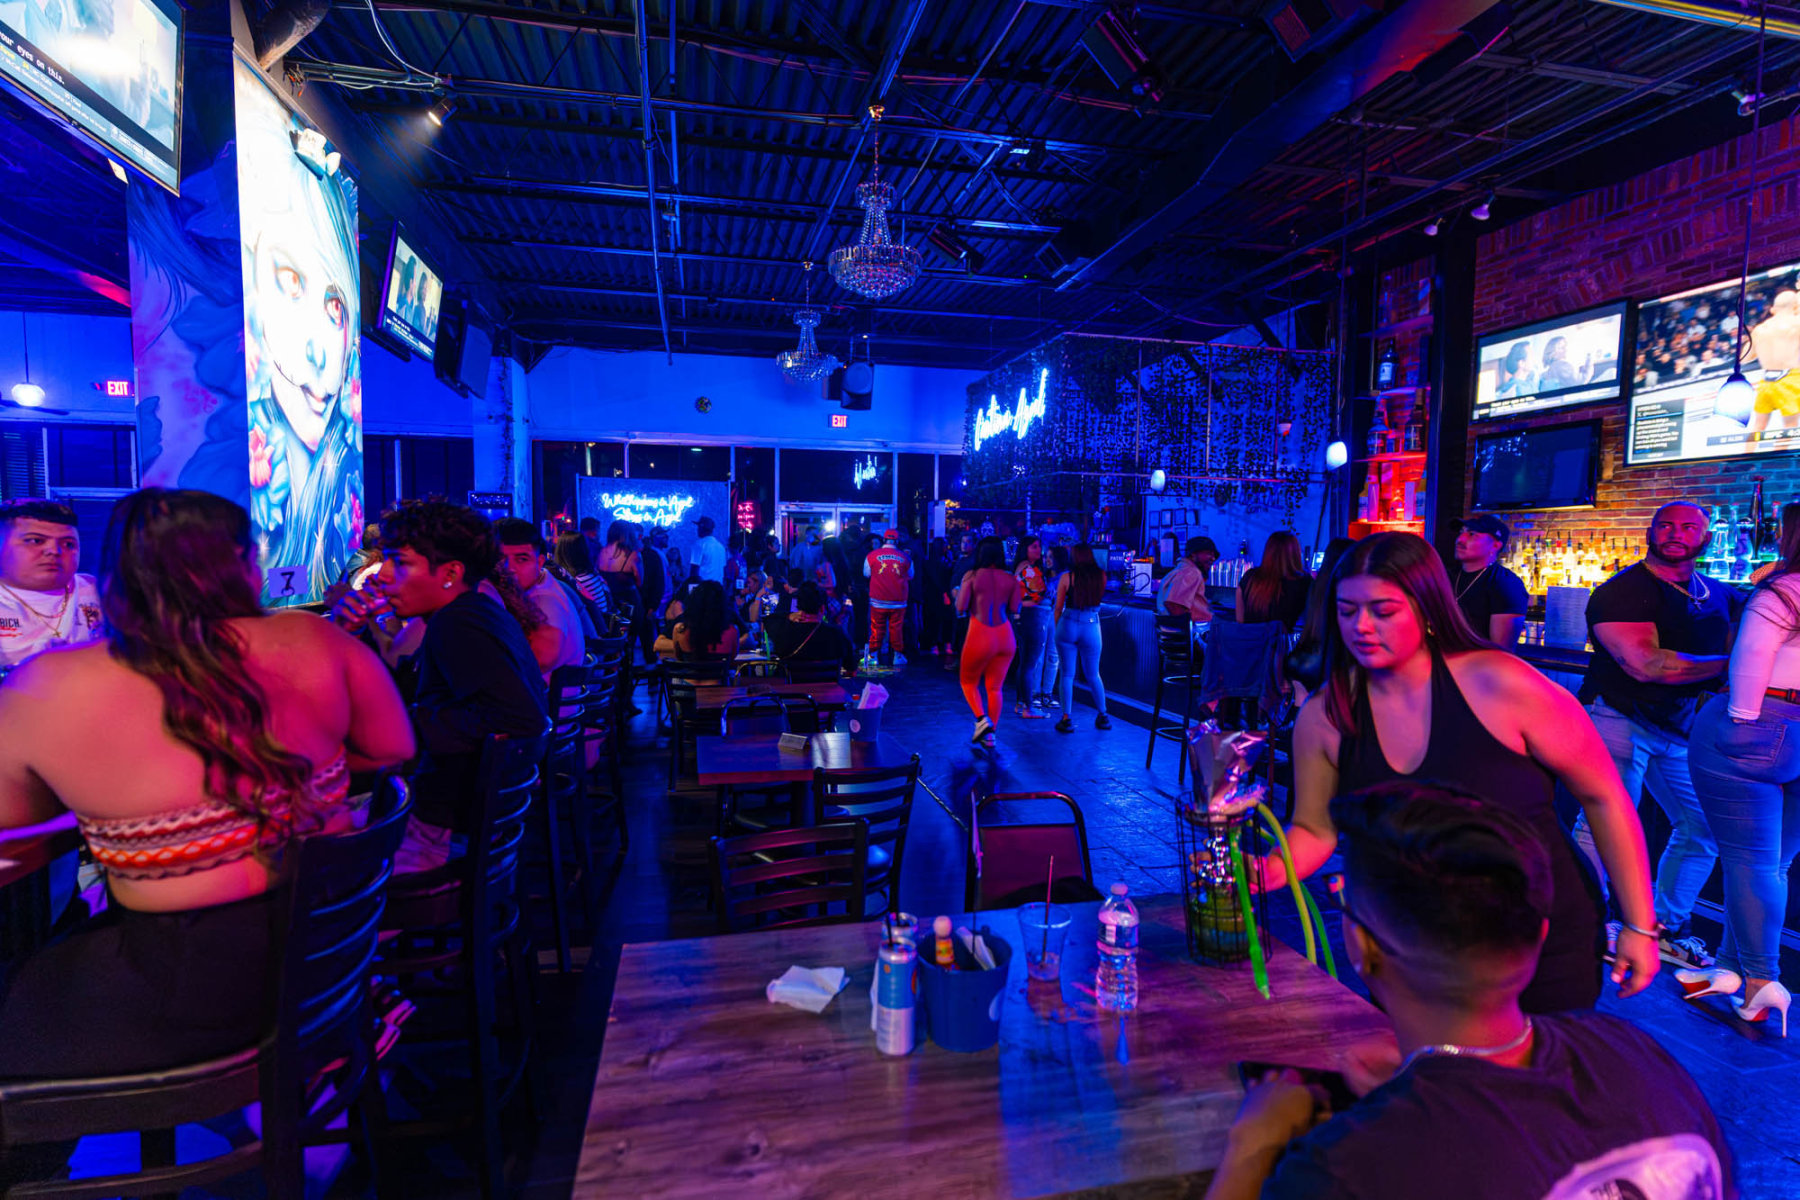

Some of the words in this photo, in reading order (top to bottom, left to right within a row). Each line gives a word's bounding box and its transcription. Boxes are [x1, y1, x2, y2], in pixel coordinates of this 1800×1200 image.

[0, 31, 14, 46] our
[17, 45, 34, 62] eyes
[36, 59, 45, 70] on
[48, 66, 65, 85] this.
[107, 380, 128, 397] EXIT
[832, 415, 847, 428] EXIT
[280, 571, 295, 591] 7
